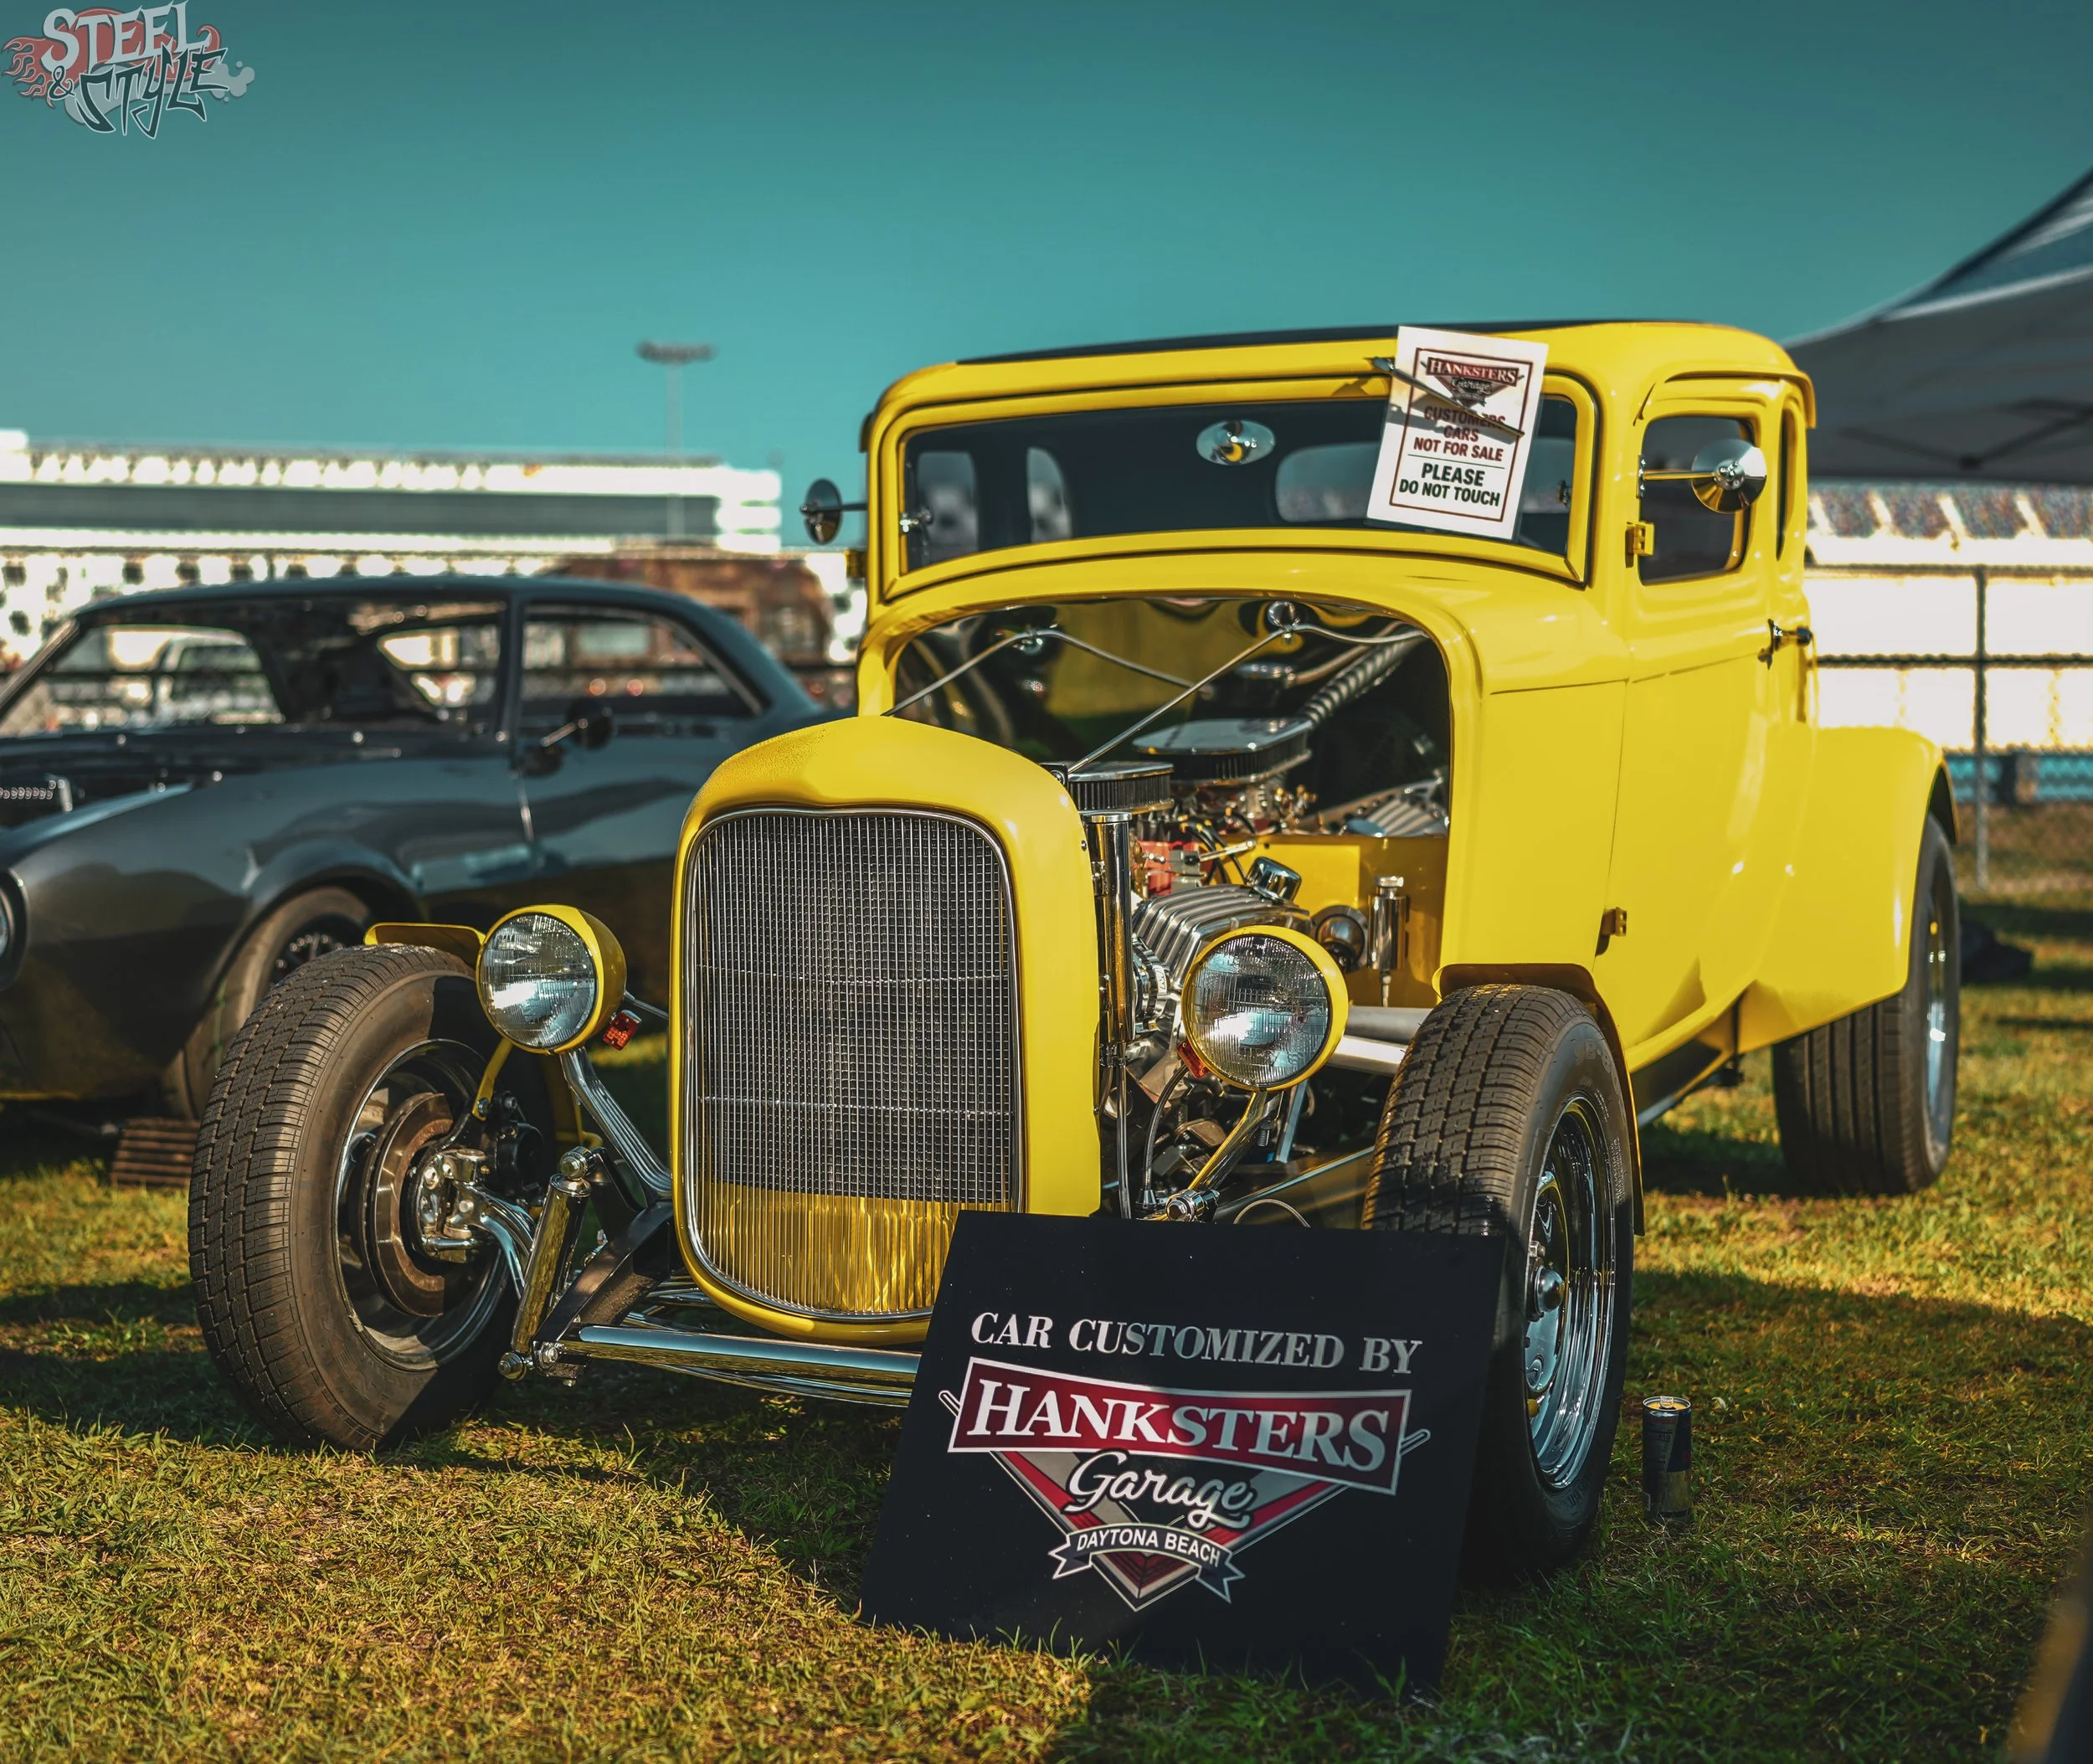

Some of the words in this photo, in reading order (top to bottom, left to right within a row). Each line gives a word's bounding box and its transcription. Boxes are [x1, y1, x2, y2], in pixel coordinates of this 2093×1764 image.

[1429, 359, 1518, 385] HANKSTERS
[1443, 425, 1479, 442] CARS
[1413, 437, 1441, 453] NOT
[1443, 441, 1468, 456] FOR
[1471, 445, 1504, 461] SALE
[1422, 462, 1485, 486] PLEASE
[1399, 479, 1418, 494] DO
[1422, 482, 1450, 499] NOT
[1453, 486, 1500, 507] TOUCH
[971, 1312, 1052, 1349] CAR
[1069, 1319, 1345, 1370] CUSTOMIZED
[1359, 1337, 1423, 1375] BY
[966, 1378, 1390, 1473] HANKSTERS
[1063, 1450, 1252, 1529] Garage
[1076, 1529, 1160, 1552] DAYTONA
[1164, 1532, 1221, 1567] BEACH
